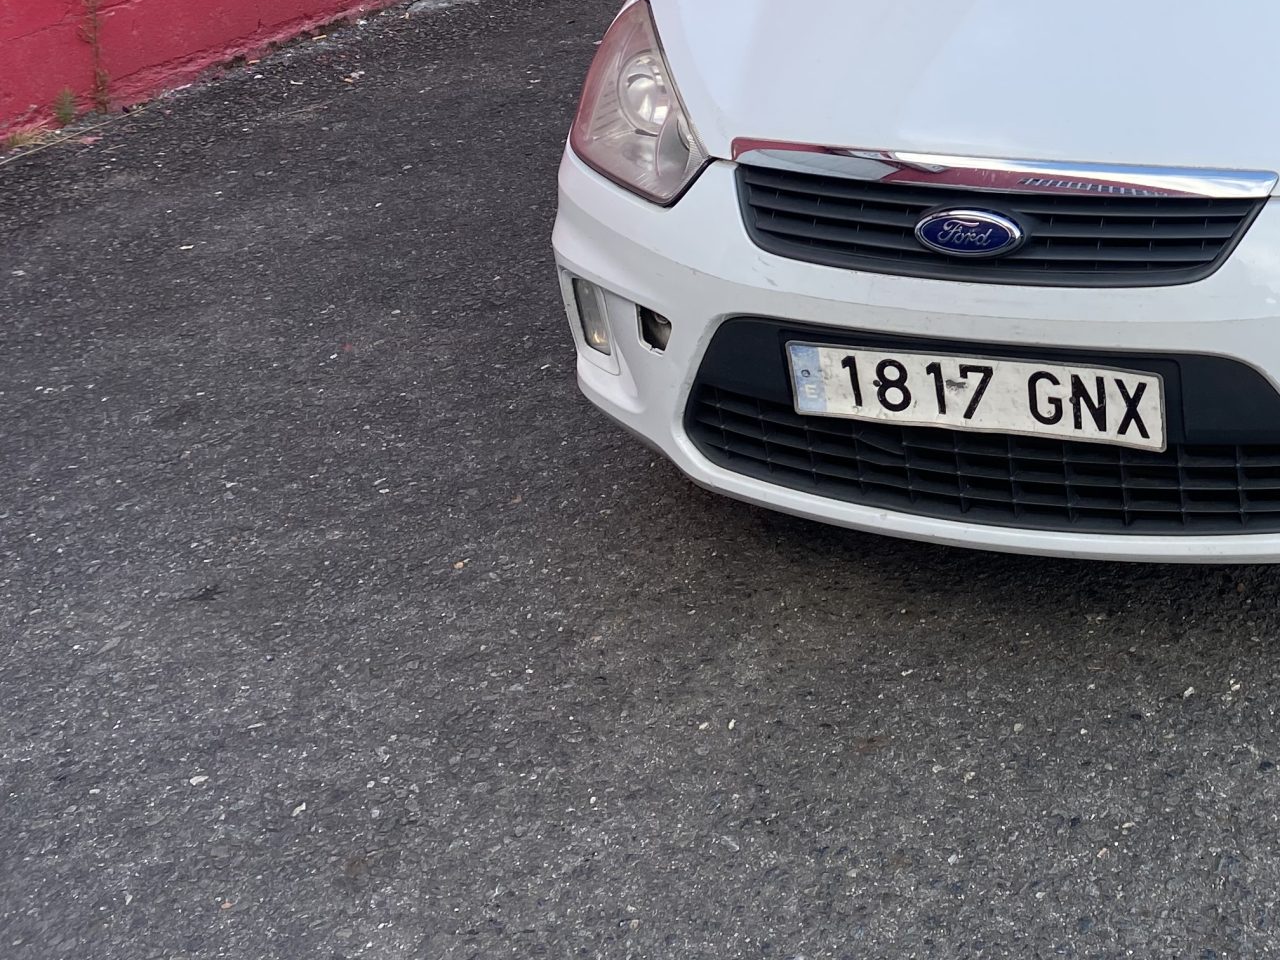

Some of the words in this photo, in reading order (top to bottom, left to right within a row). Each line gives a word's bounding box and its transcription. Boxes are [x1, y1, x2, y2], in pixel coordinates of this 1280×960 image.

[937, 219, 993, 246] Ford
[804, 384, 818, 399] E
[841, 355, 994, 420] 1817
[1027, 370, 1150, 439] GNX
